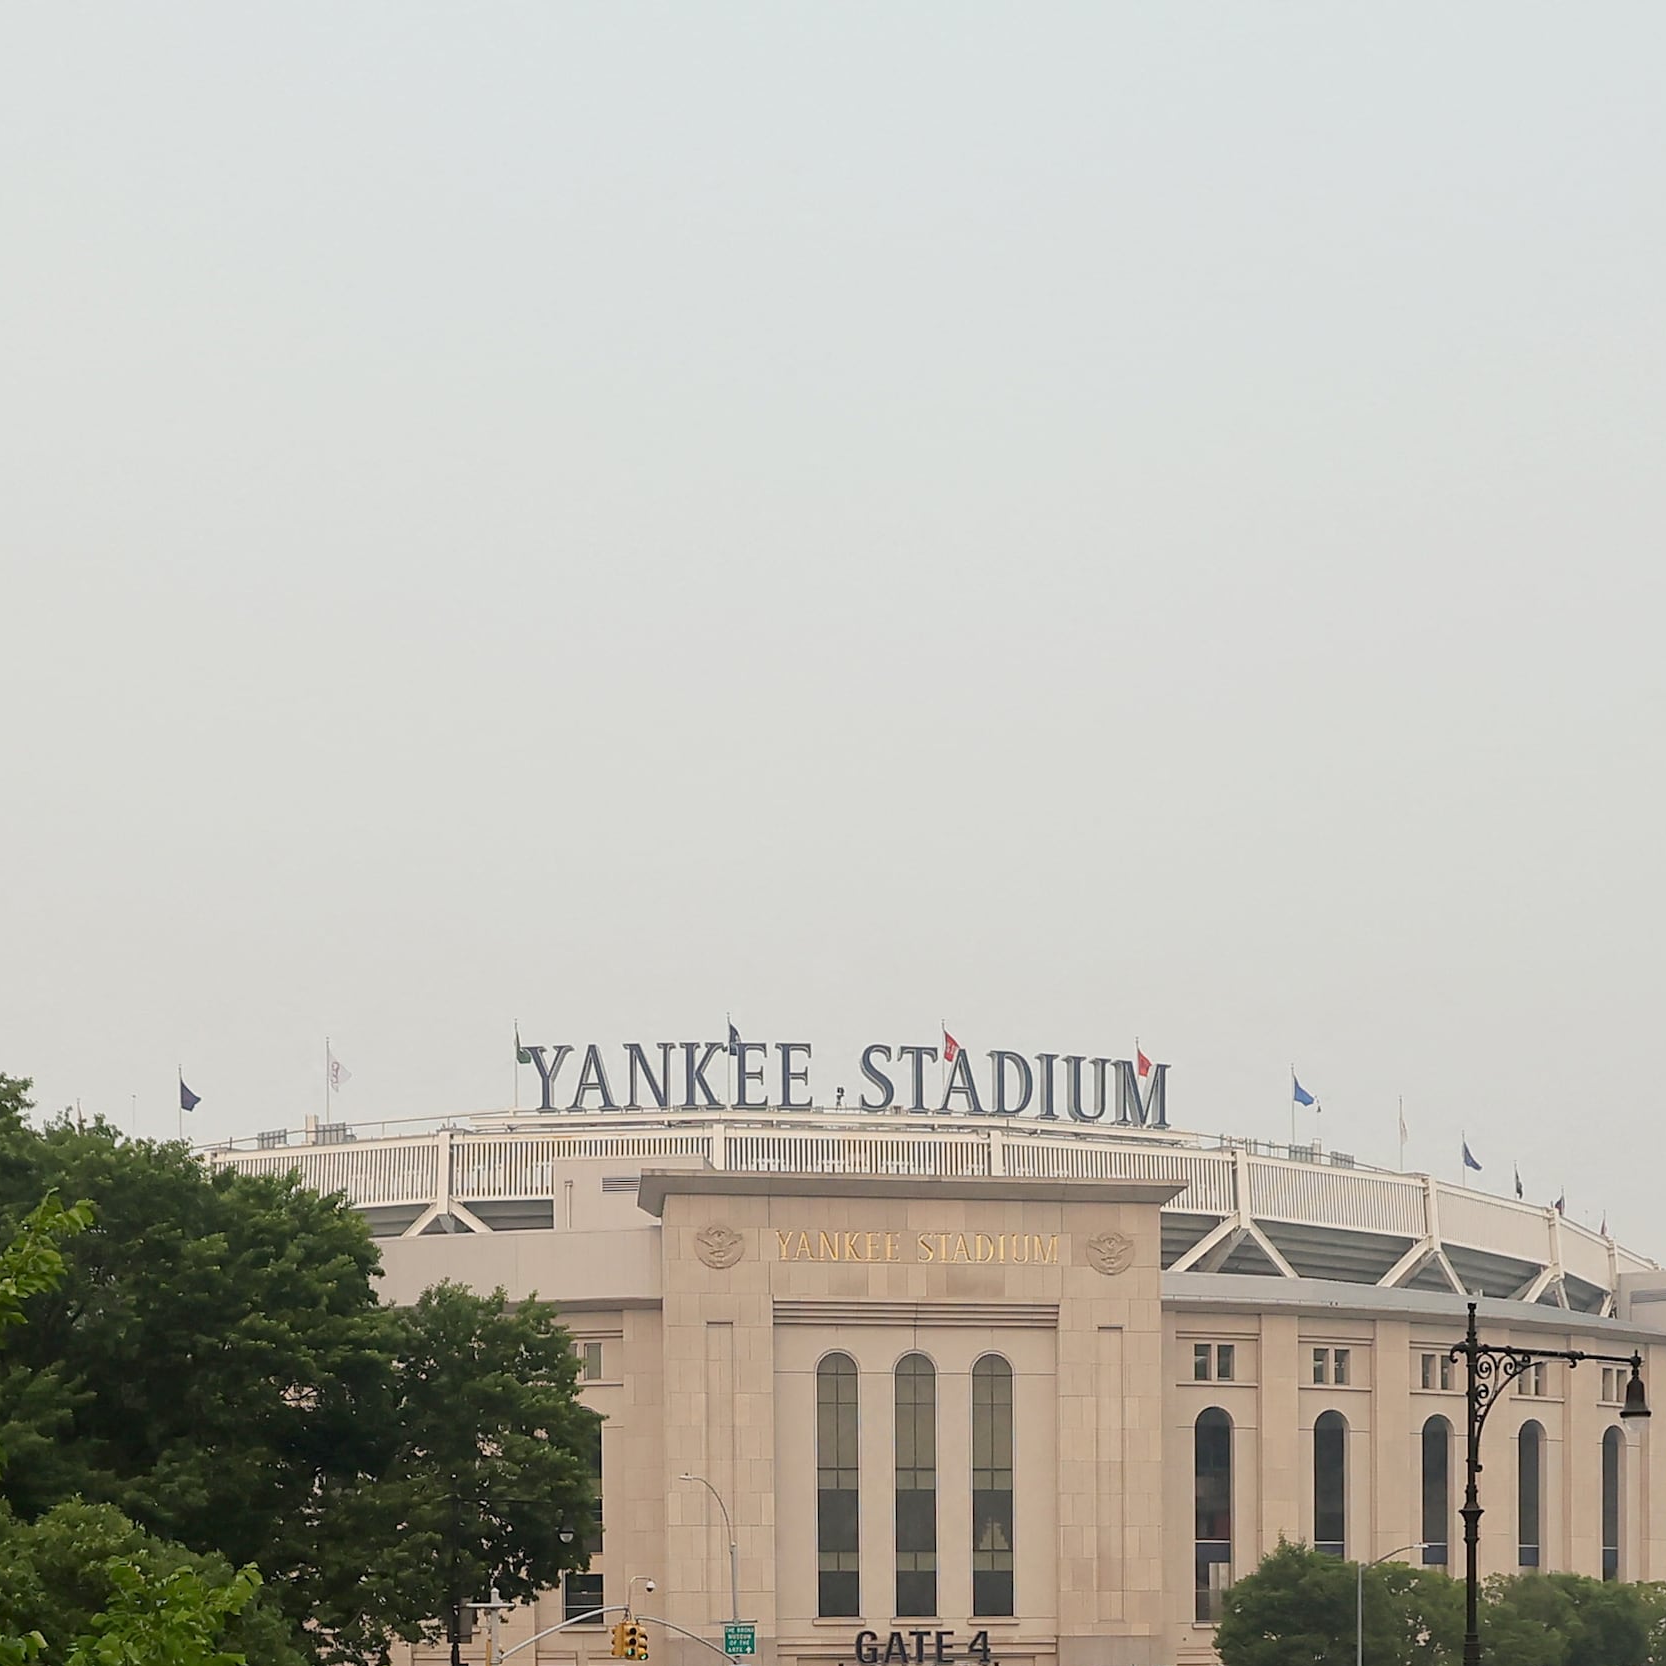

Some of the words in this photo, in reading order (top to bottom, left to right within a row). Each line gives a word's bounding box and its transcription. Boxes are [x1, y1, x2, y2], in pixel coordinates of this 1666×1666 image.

[522, 1041, 813, 1113] YANKEE
[859, 1043, 1172, 1130] STADIUM
[775, 1229, 901, 1263] YANKEE
[916, 1231, 1059, 1265] STADIUM
[855, 1630, 955, 1666] GATE
[967, 1630, 992, 1666] 4
